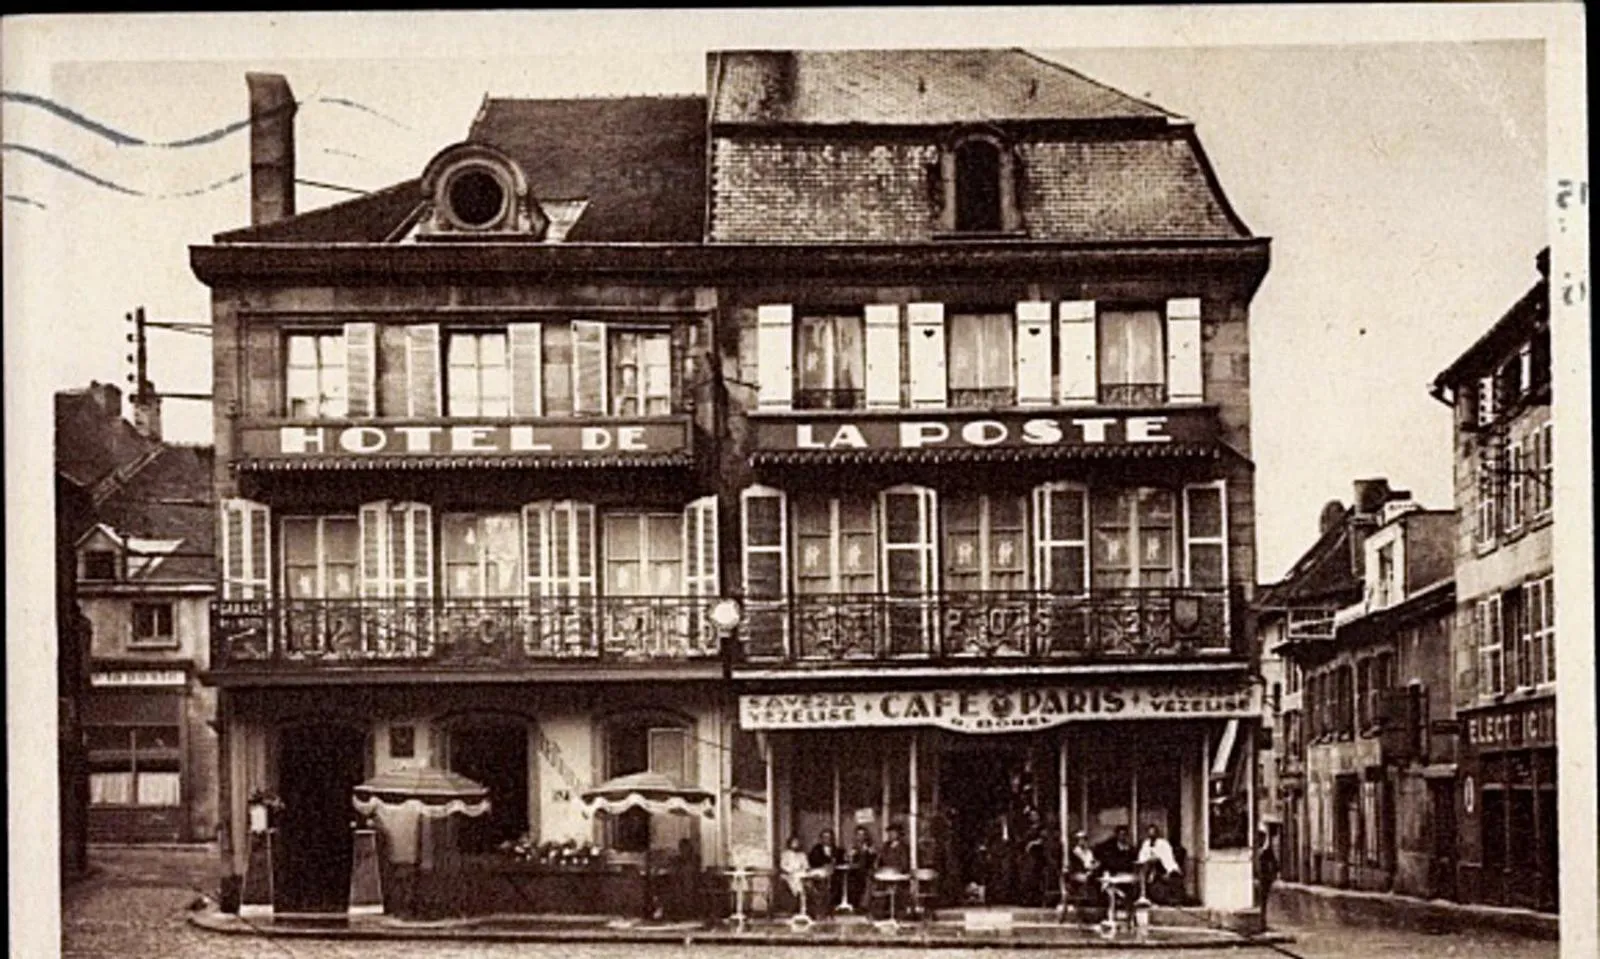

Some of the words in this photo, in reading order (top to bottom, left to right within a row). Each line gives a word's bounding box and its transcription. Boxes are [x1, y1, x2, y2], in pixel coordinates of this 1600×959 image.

[281, 427, 552, 453] HOTEL
[582, 427, 646, 449] DE
[798, 426, 866, 447] LA
[900, 418, 1170, 447] POSTE
[1020, 686, 1125, 714] PARIS
